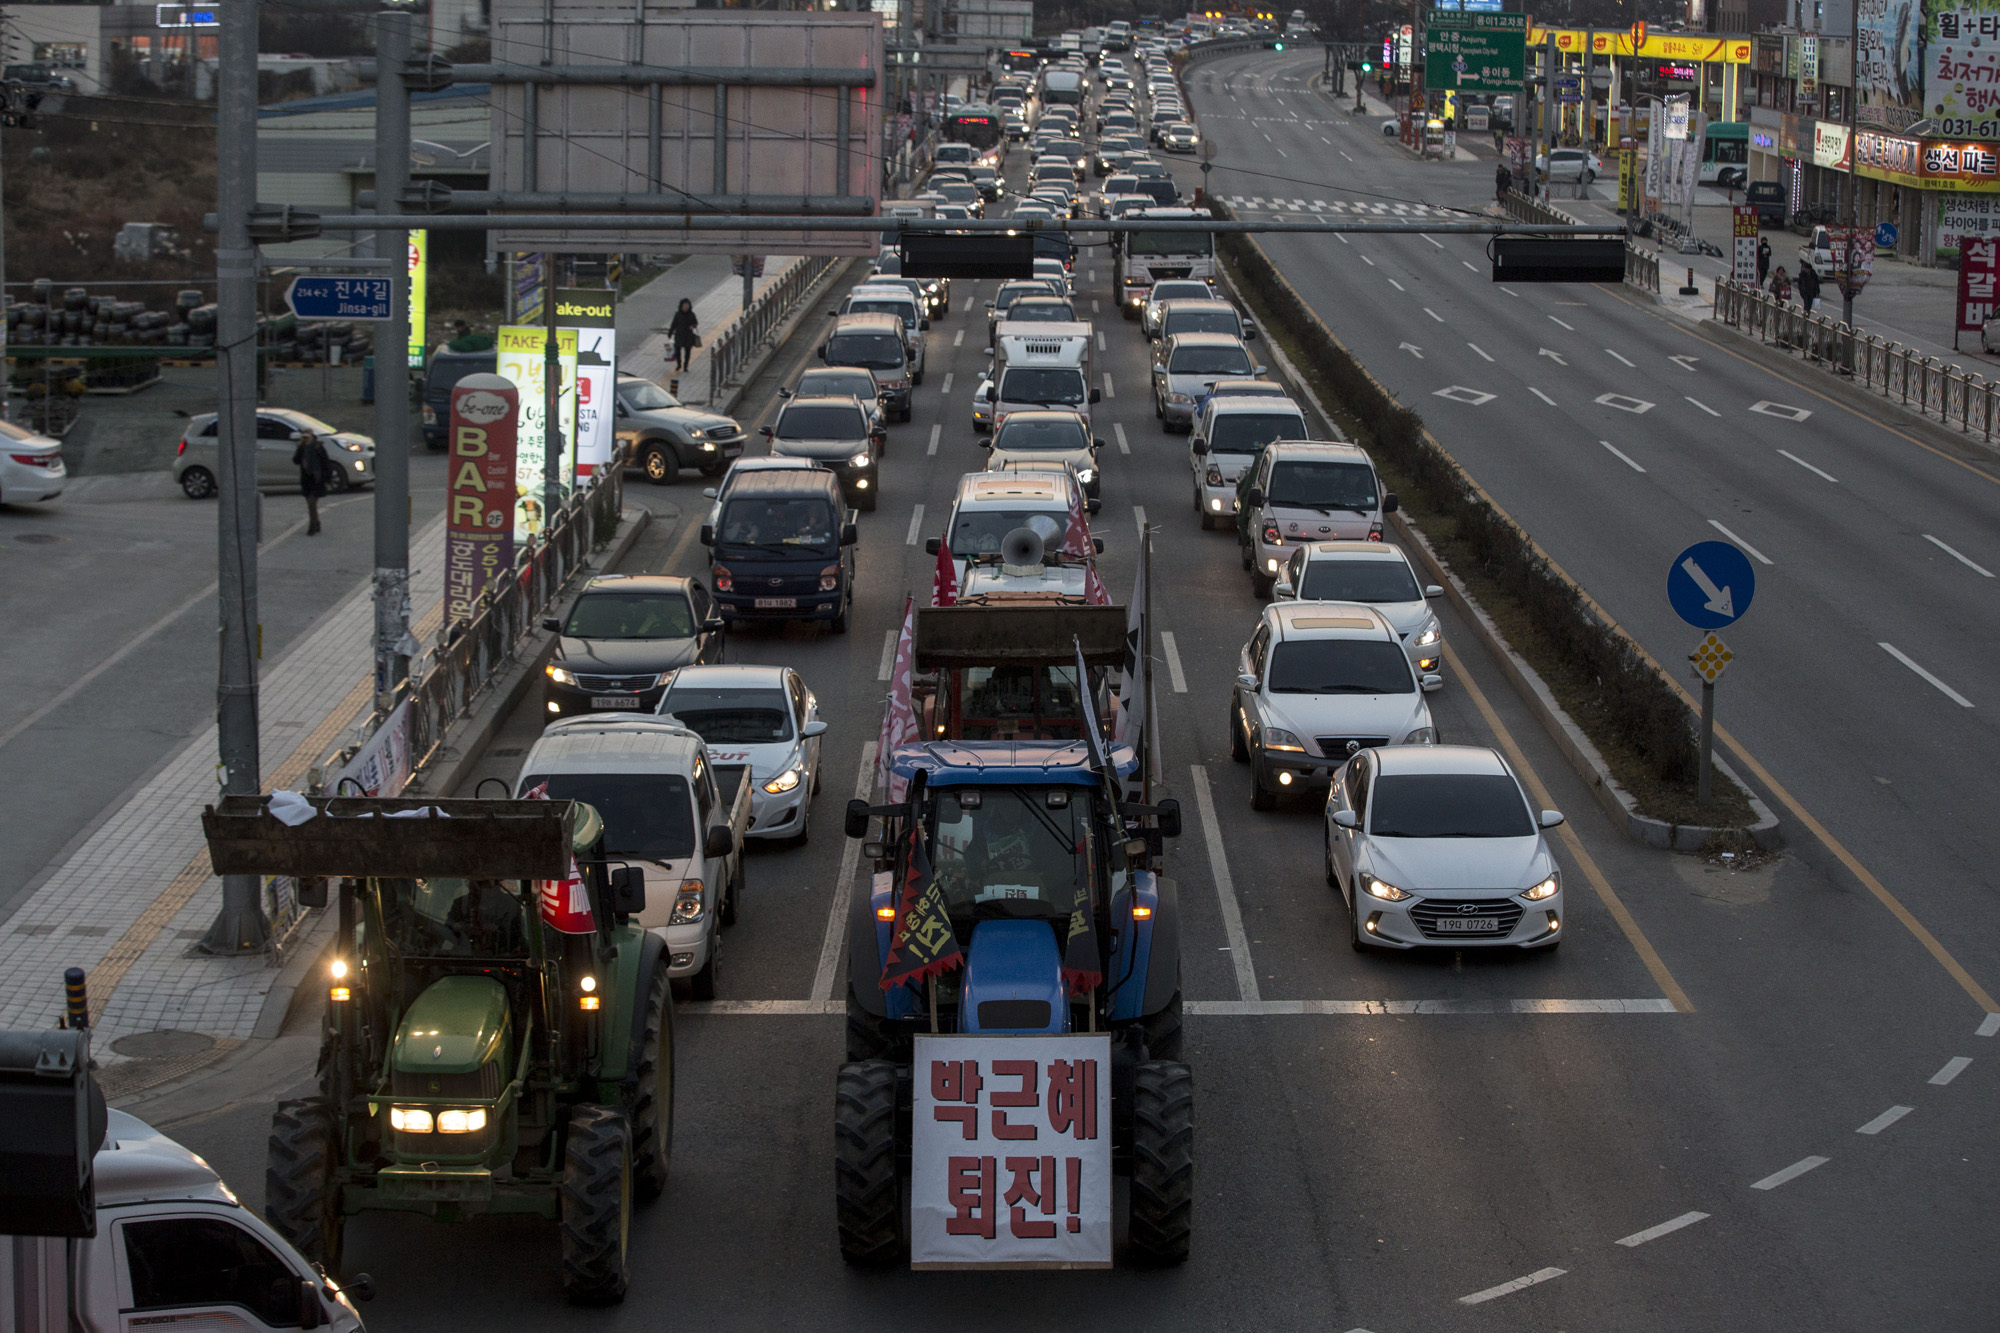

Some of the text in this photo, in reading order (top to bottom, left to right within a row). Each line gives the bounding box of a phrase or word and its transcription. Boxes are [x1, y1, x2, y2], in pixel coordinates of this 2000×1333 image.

[1461, 36, 1487, 44] Anjung
[1481, 67, 1511, 77] 용이동
[1482, 78, 1524, 87] Yongi-dong
[1942, 117, 2000, 137] 031-61
[1924, 148, 1997, 175] 생선 파는
[1945, 199, 1989, 214] 생선처럼
[1943, 216, 1989, 231] 타이어를
[334, 281, 387, 300] 진사길
[1964, 242, 1997, 325] 석갈비
[337, 302, 387, 316] Jinsa-gil
[502, 335, 575, 351] TAKE-UT
[453, 425, 489, 528] BAR
[488, 514, 502, 525] 2F
[1466, 919, 1493, 930] 0726
[931, 1058, 1098, 1141] 박근혜
[946, 1155, 1082, 1240] 퇴진!
